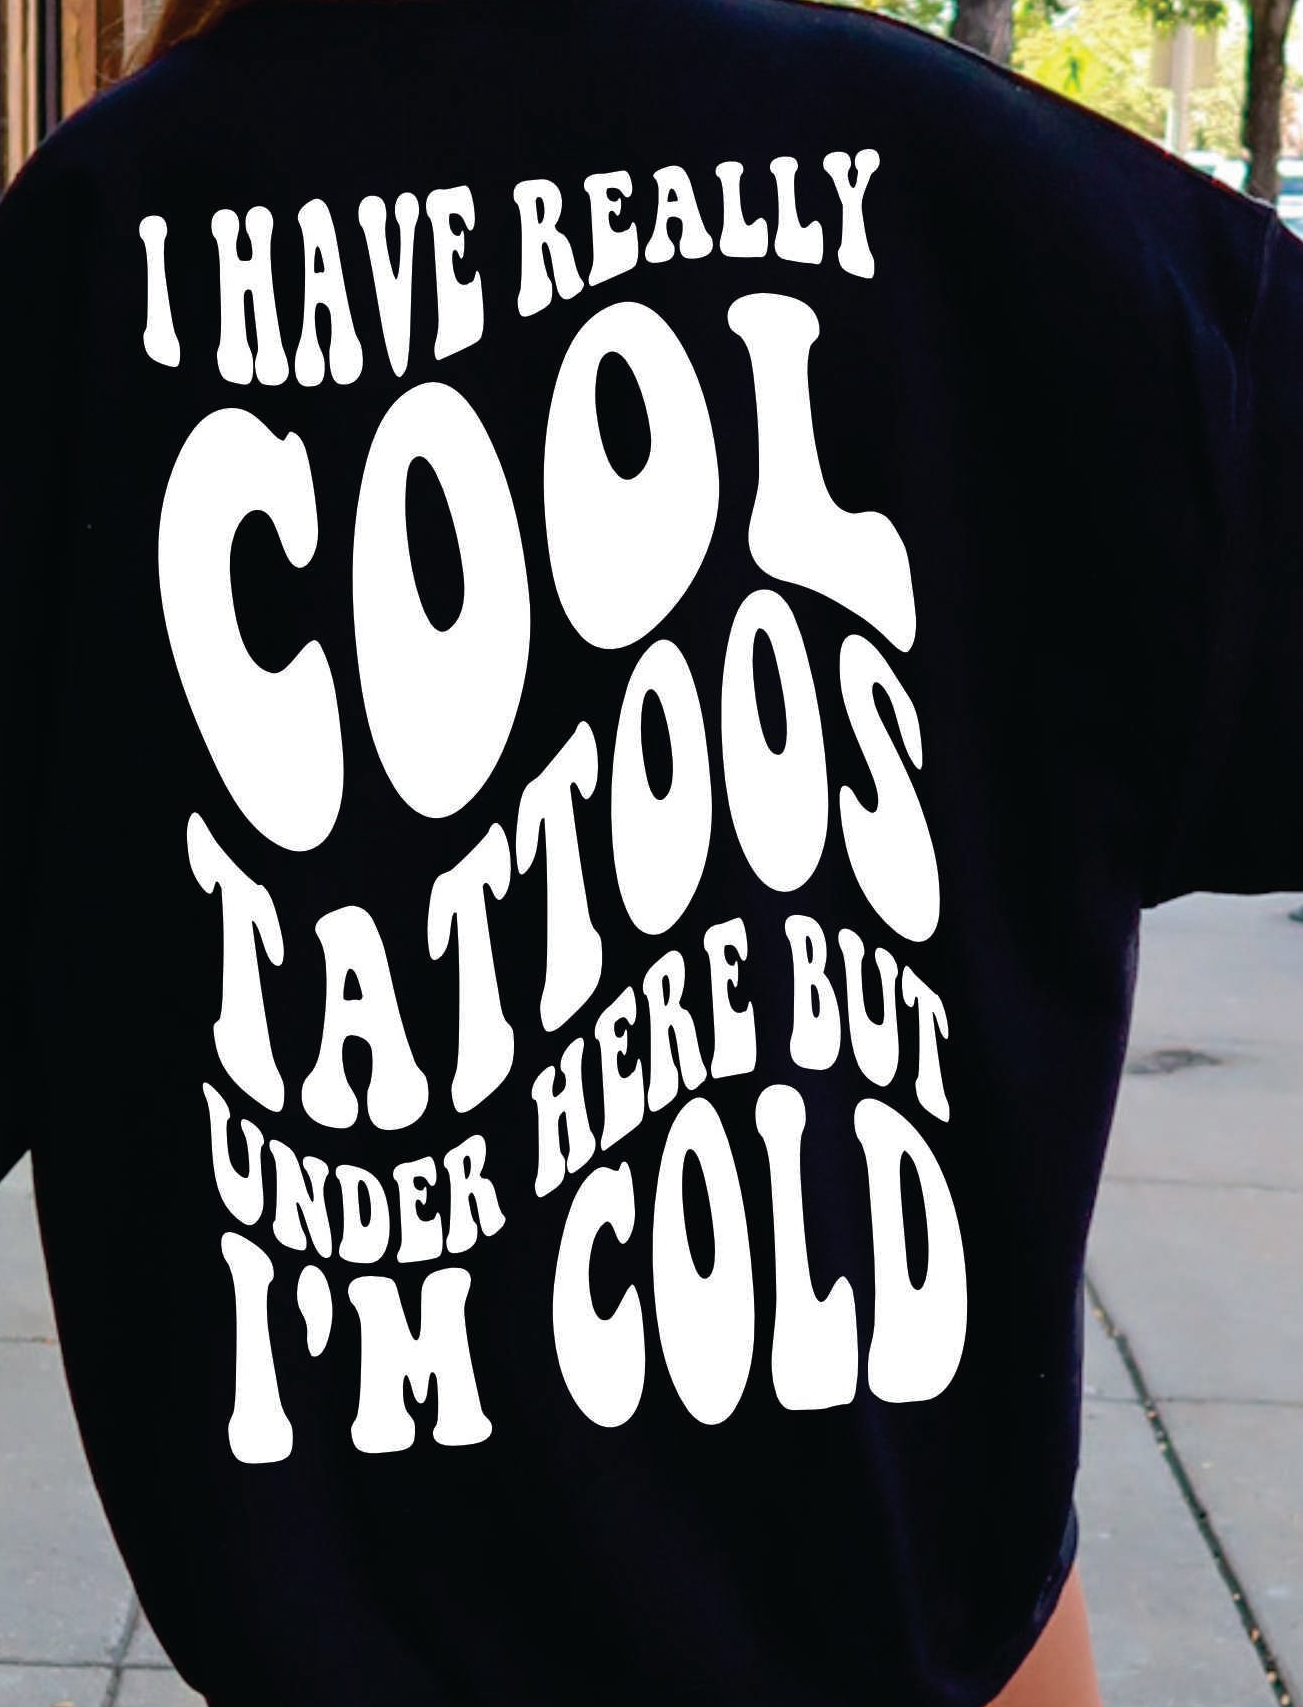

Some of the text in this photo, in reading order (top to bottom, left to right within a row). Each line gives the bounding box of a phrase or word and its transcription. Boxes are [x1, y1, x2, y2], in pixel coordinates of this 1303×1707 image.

[139, 149, 880, 387] I HAVE REALLY
[158, 293, 916, 851] COOL
[187, 590, 940, 1130] TATTOOS
[203, 915, 949, 1263] UNDER HERE BUT
[221, 1084, 967, 1463] I'M COLD
